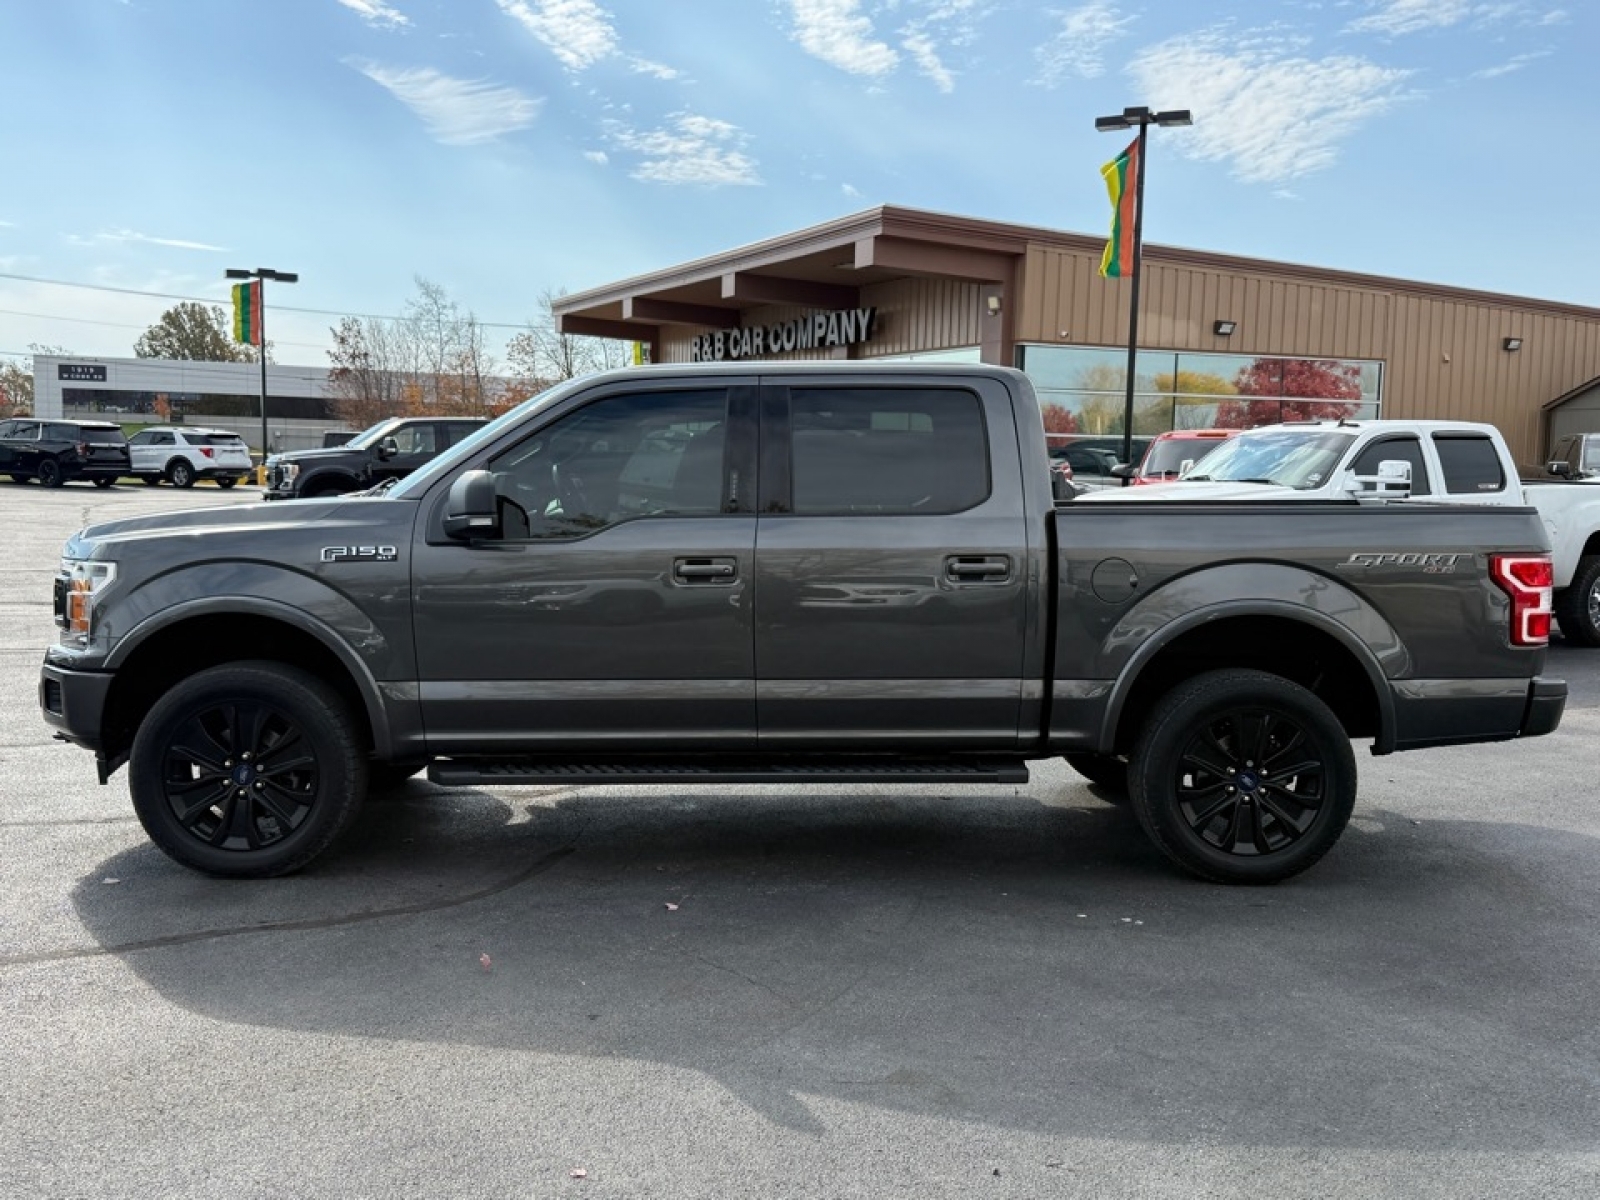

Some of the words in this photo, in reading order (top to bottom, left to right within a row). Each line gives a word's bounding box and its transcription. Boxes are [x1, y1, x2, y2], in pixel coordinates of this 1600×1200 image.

[692, 331, 726, 362] R&B
[729, 327, 764, 358] CAR
[769, 308, 874, 353] COMPANY
[1336, 553, 1473, 567] SPORT
